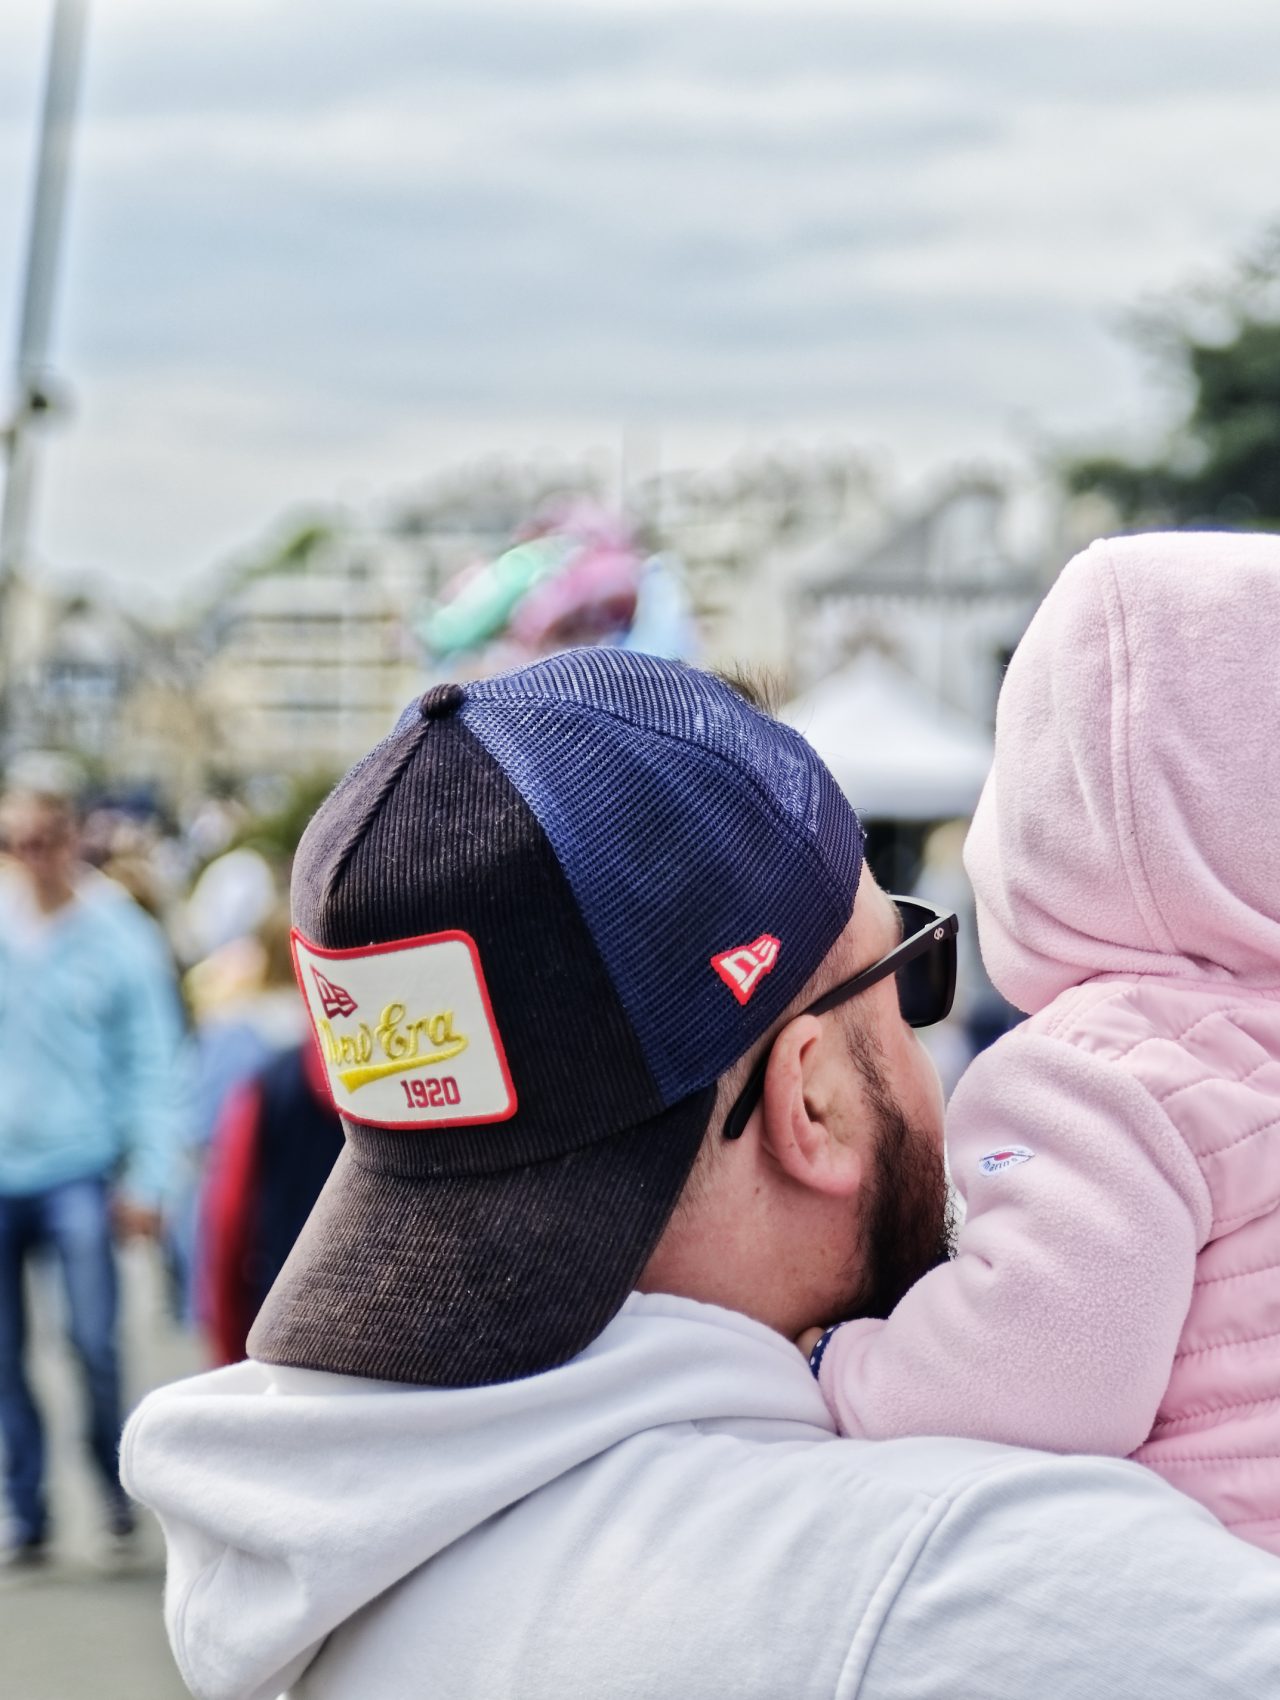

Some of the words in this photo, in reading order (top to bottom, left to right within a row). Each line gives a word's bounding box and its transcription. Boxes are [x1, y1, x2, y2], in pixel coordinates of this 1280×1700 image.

[319, 1020, 373, 1067] New
[375, 1003, 465, 1060] Era
[401, 1077, 461, 1109] 1920
